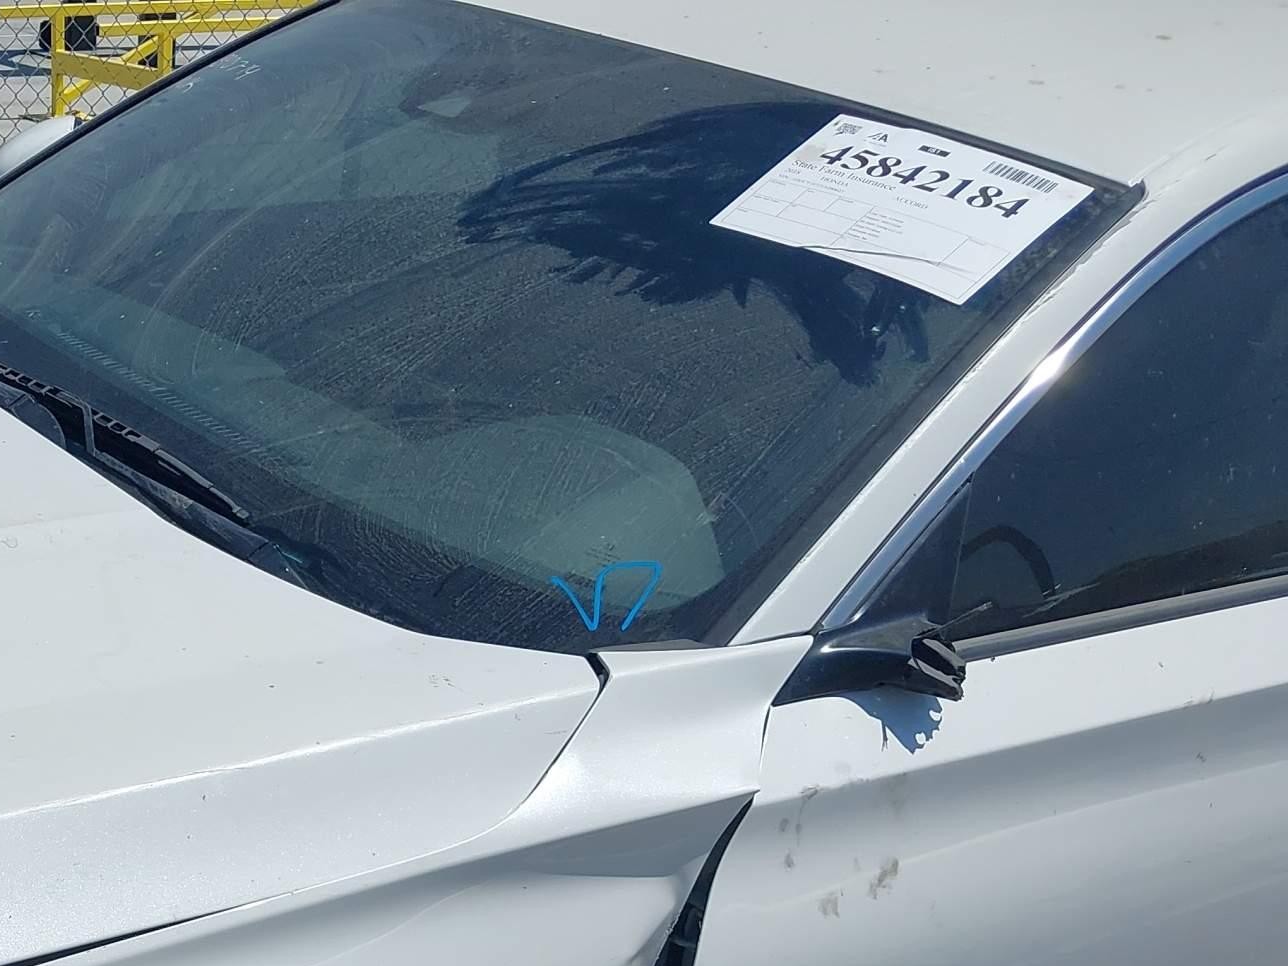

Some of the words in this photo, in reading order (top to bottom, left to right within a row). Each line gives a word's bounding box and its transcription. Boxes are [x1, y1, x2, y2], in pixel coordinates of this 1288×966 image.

[791, 159, 818, 171] State
[818, 165, 846, 178] Farm
[846, 172, 897, 192] Insurance
[819, 145, 1031, 218] 45842184
[820, 176, 850, 187] HONDA
